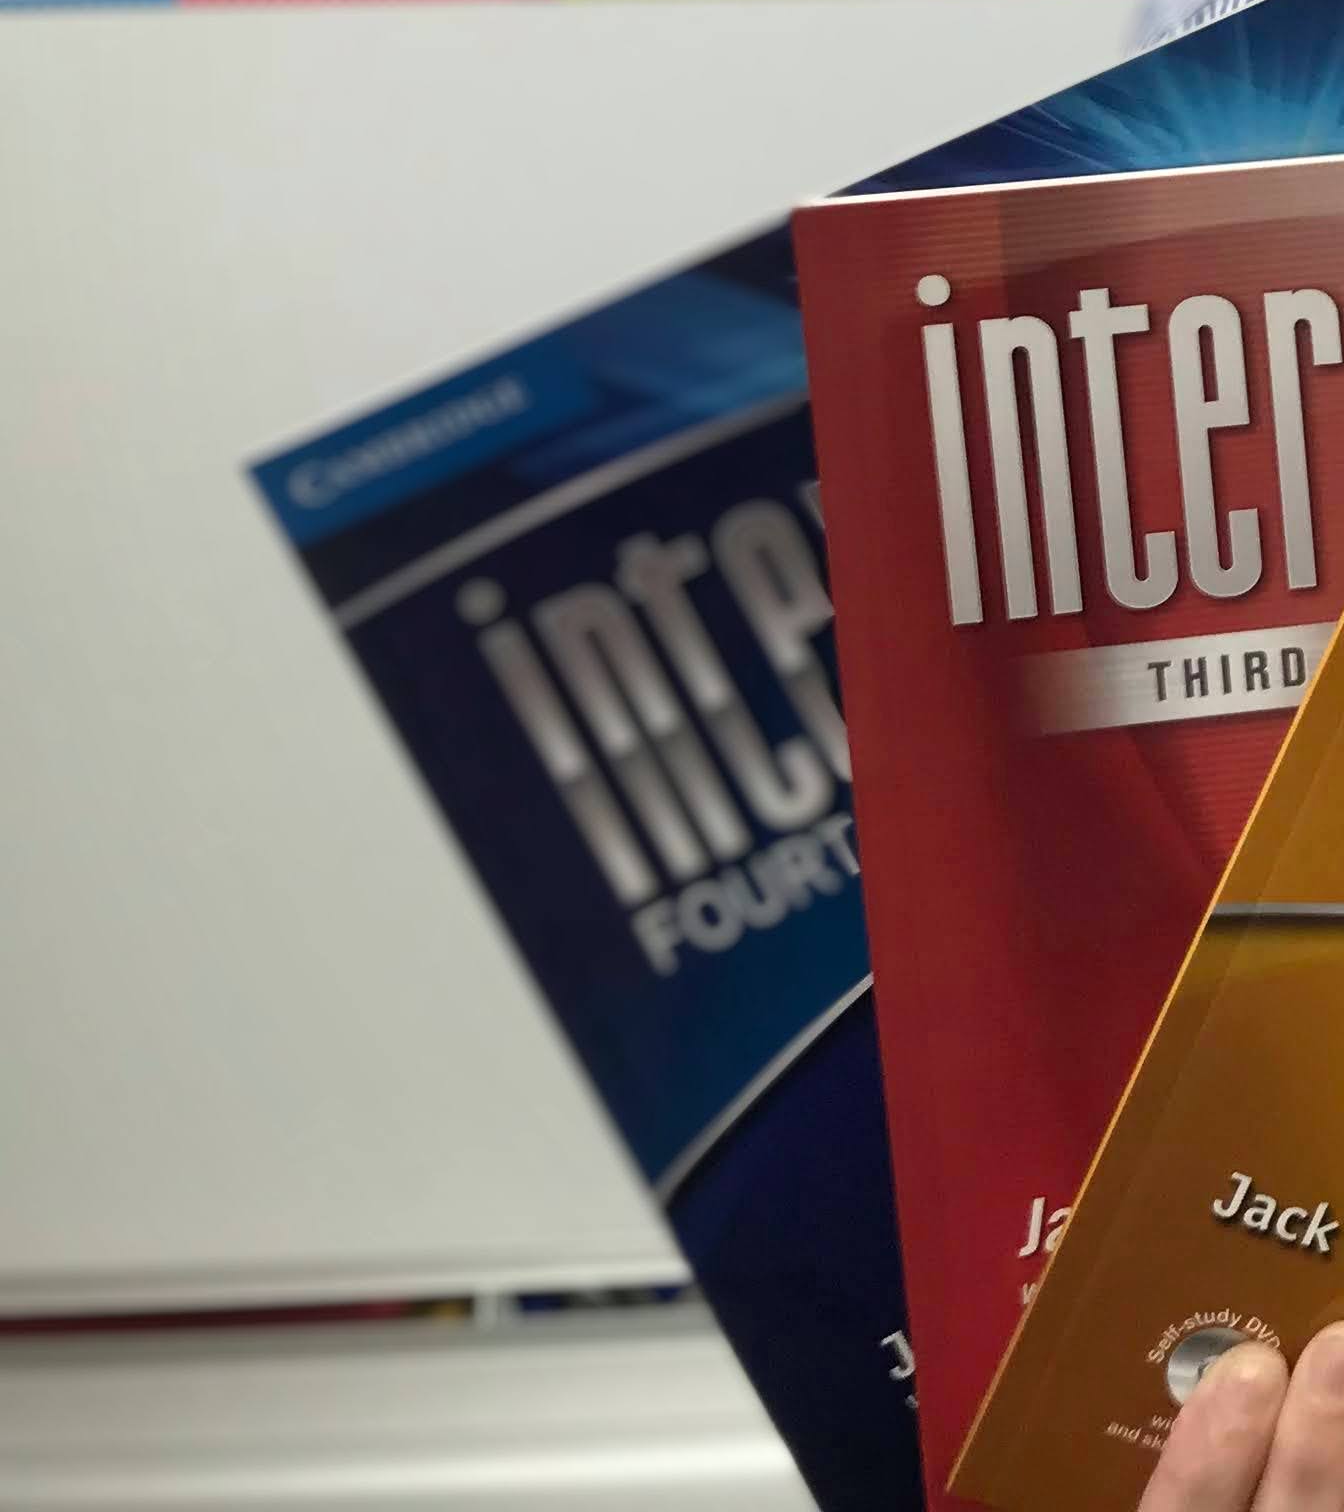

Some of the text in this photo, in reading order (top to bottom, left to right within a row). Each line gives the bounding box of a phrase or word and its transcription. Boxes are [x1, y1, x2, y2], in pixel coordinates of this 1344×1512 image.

[1146, 644, 1310, 703] THIRD
[1211, 1171, 1340, 1256] Jack
[1147, 1308, 1241, 1364] Self-study
